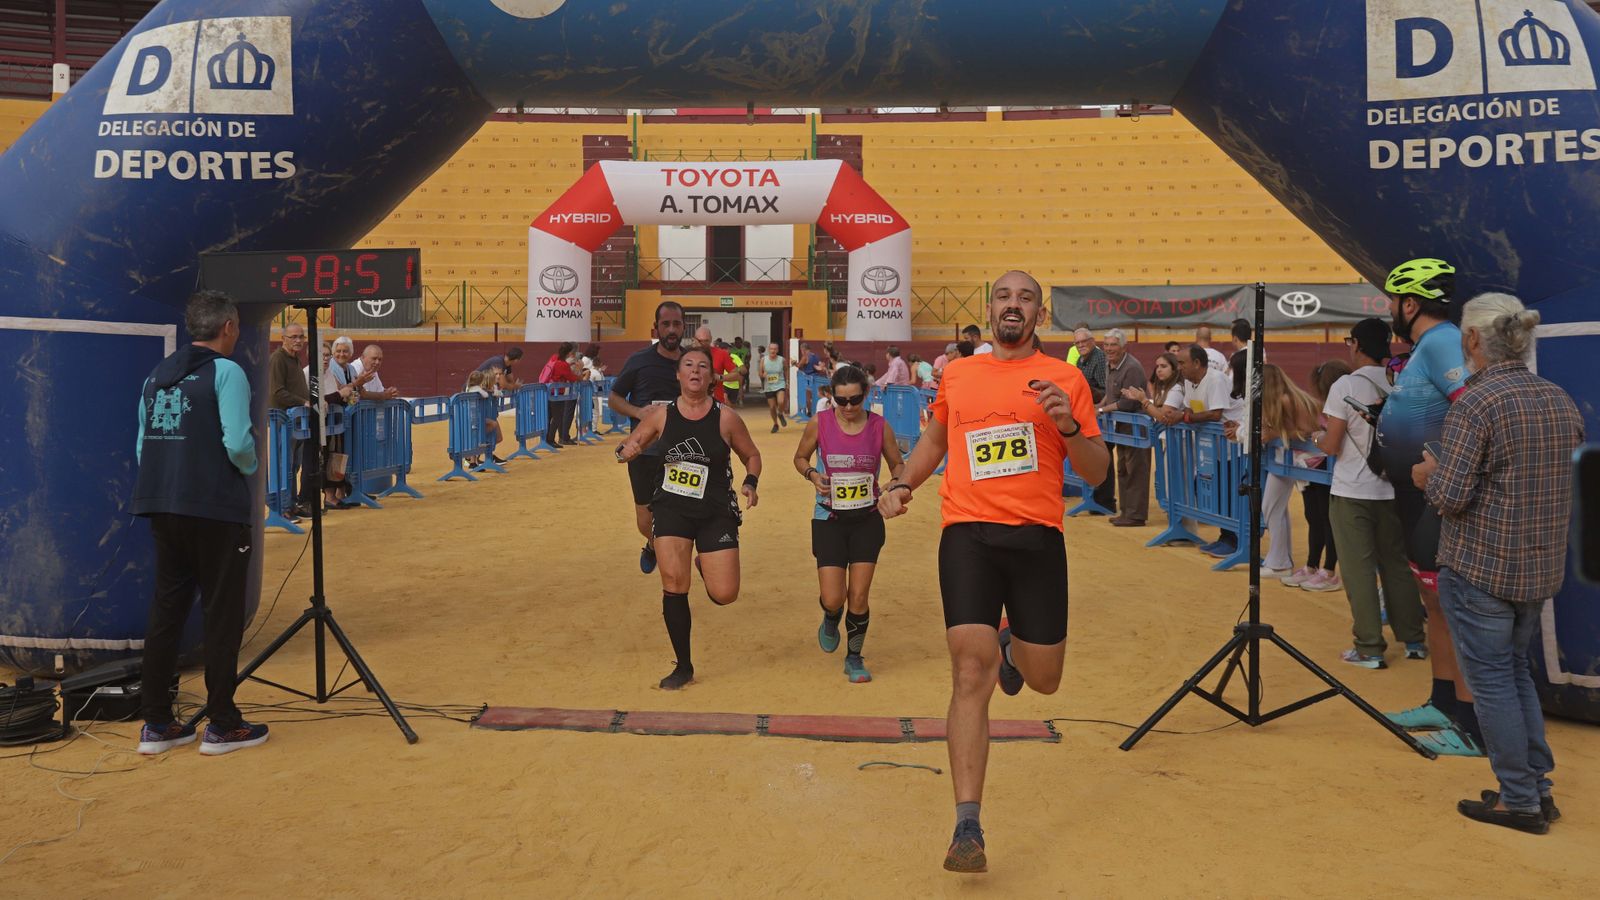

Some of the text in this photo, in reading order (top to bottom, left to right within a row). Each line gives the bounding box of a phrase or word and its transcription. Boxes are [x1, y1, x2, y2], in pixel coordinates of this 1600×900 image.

[1395, 17, 1454, 78] D
[126, 45, 172, 96] D
[1367, 98, 1560, 126] DELEGACIÓN DE
[99, 118, 256, 138] DELEGACIÓN DE
[1369, 128, 1600, 170] DEPORTES
[94, 150, 296, 180] DEPORTES
[661, 168, 780, 187] TOYOTA
[660, 195, 779, 214] A. TOMAX
[550, 213, 611, 224] HYBRID
[830, 212, 894, 225] HYBRID
[536, 296, 581, 308] TOYOTA
[857, 297, 902, 308] TOYOTA
[1087, 297, 1239, 315] TOYOTA TOMAX
[536, 309, 583, 319] A. TOMAX
[857, 309, 903, 319] A. TOMAX
[976, 439, 1027, 463] 378
[669, 468, 701, 486] 380
[837, 484, 868, 498] 375
